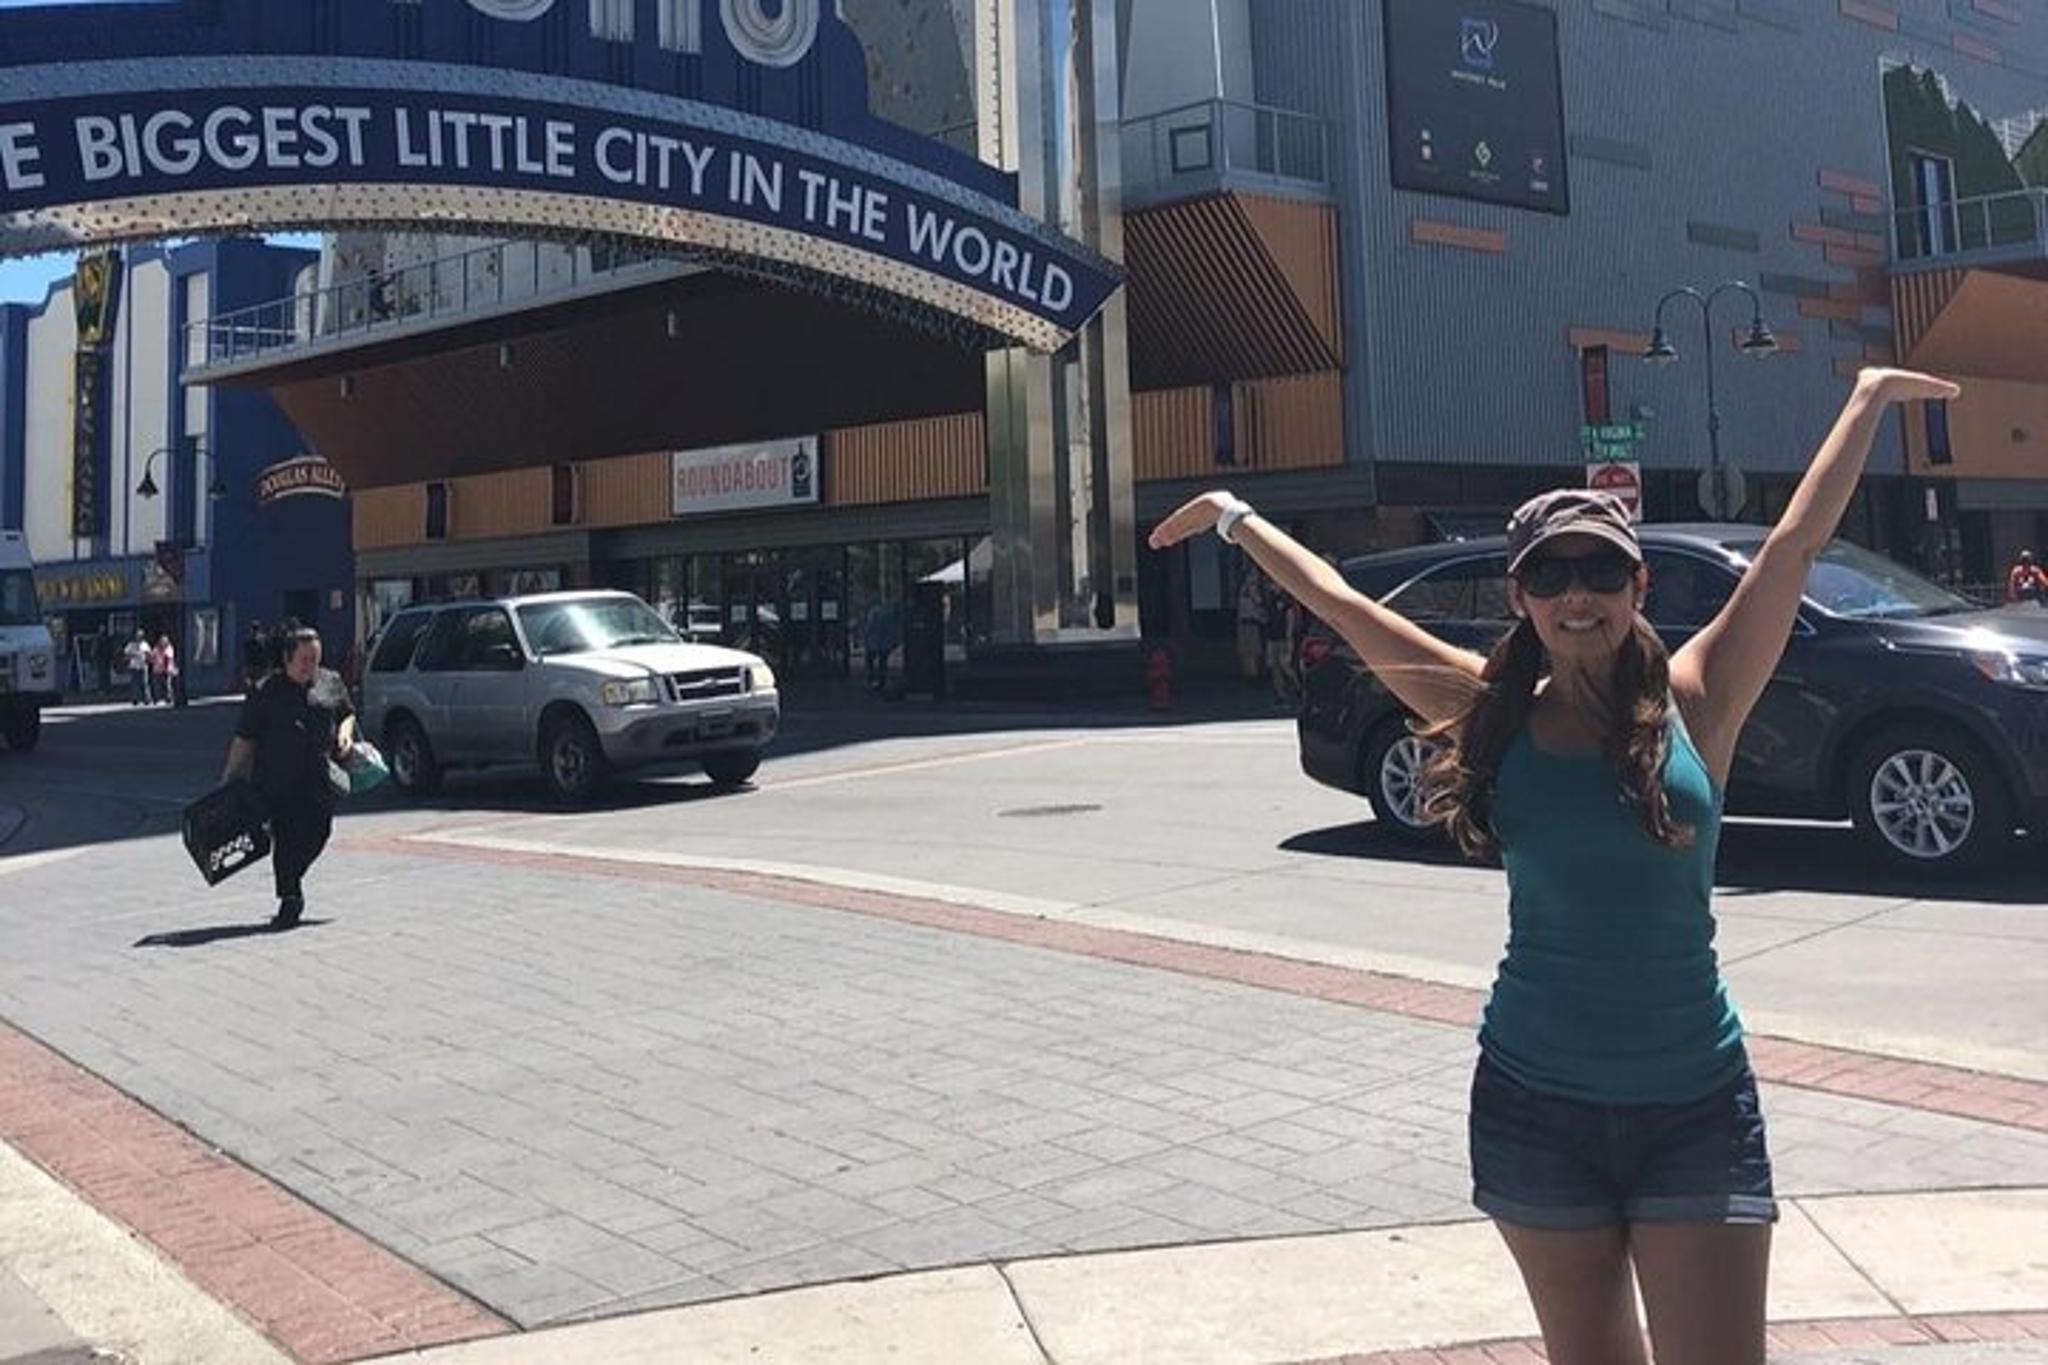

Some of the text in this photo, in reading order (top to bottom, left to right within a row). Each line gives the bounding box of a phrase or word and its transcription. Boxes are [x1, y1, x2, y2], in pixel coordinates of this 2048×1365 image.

[75, 106, 370, 180] BIGGEST
[394, 107, 575, 177] LITTLE
[594, 129, 715, 194] CITY
[729, 152, 783, 212] IN
[799, 170, 888, 241] THE
[906, 204, 1072, 311] WORLD
[677, 458, 788, 498] ROUNDABOUT
